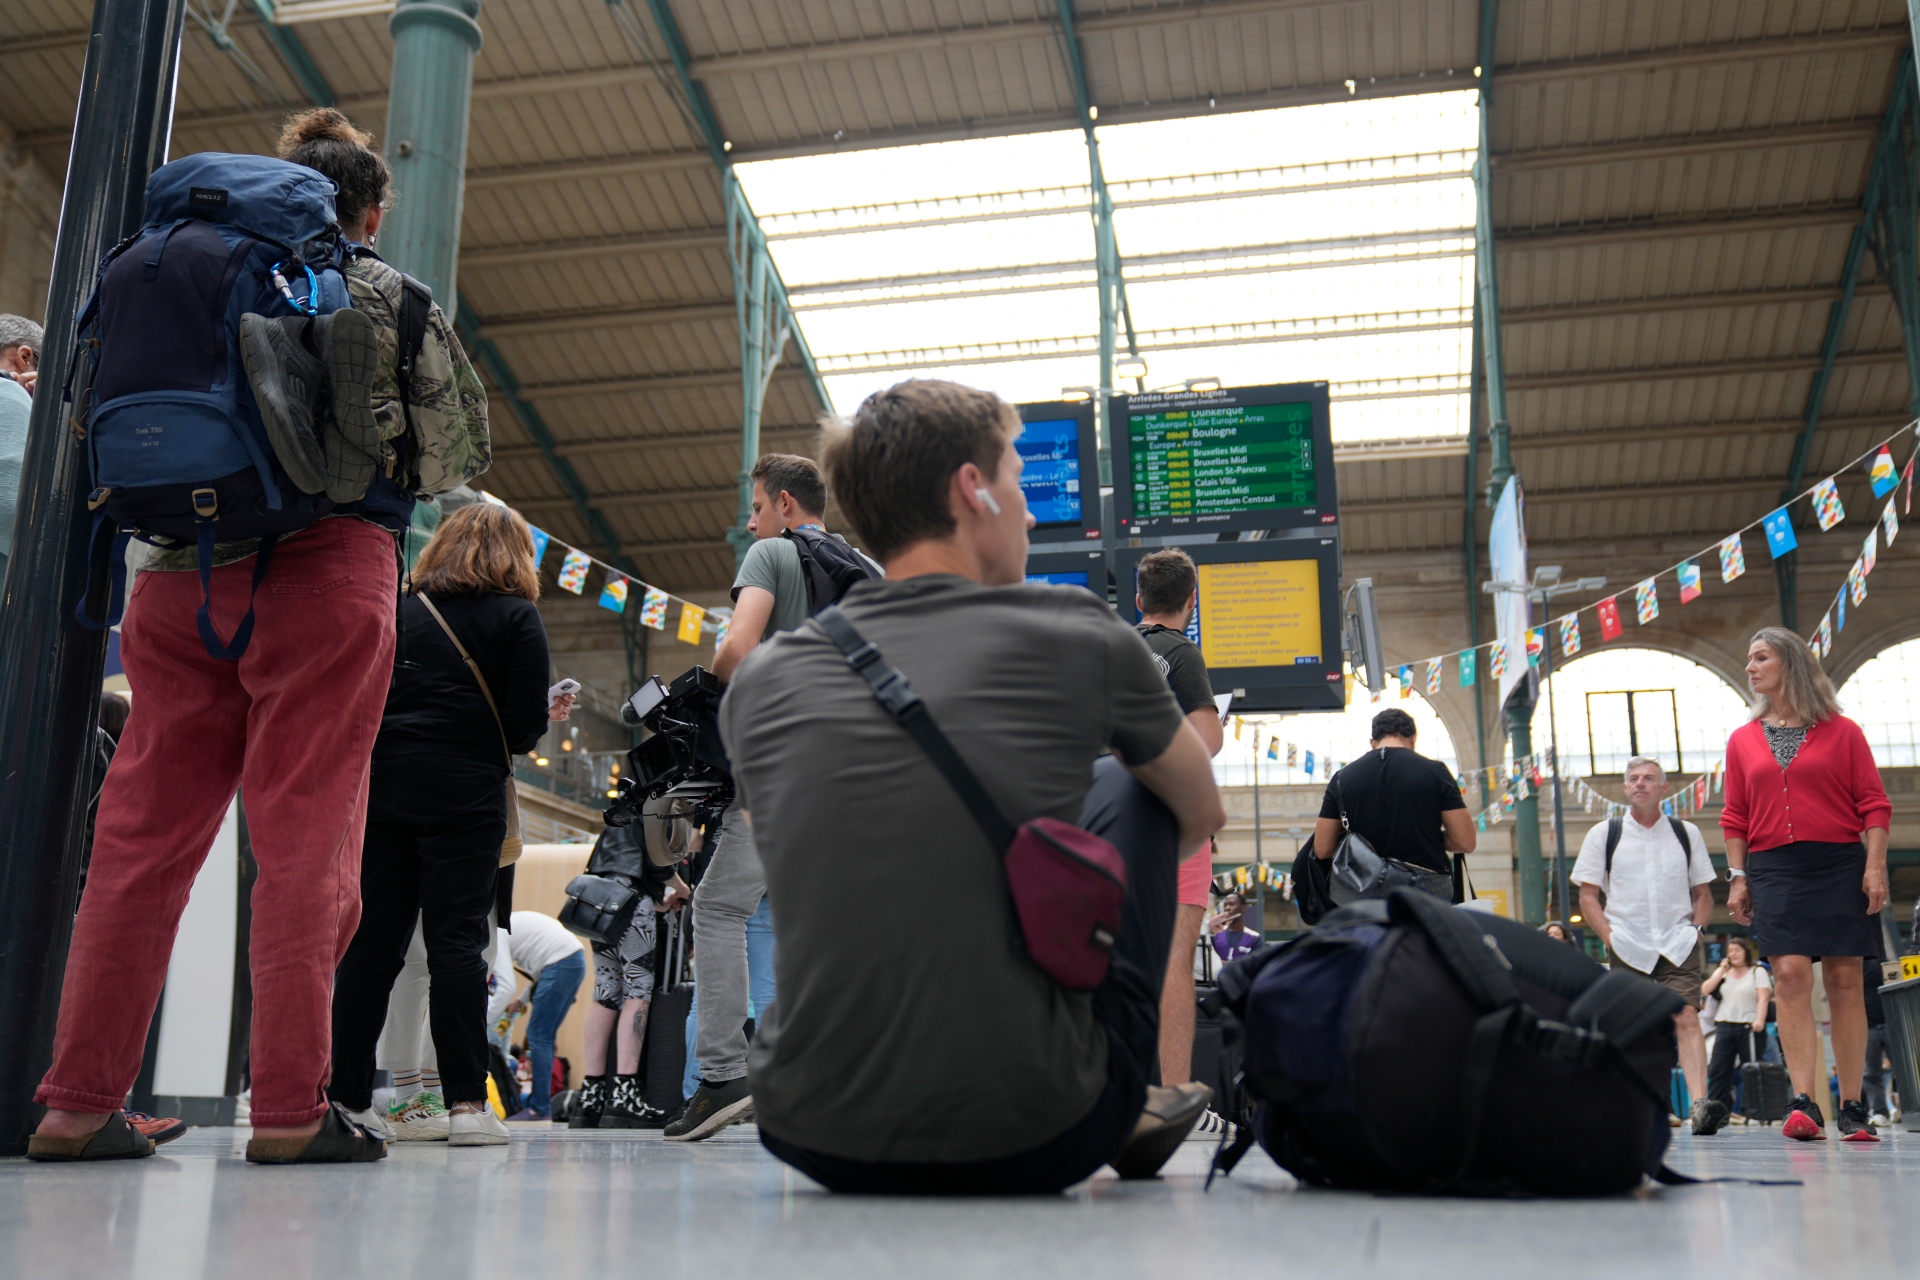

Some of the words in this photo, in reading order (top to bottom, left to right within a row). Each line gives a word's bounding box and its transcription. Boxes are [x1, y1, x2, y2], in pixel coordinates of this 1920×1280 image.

[1128, 394, 1162, 404] Arrivées
[1164, 391, 1198, 400] Grandes
[1200, 390, 1227, 399] Lignes
[1146, 420, 1187, 430] Dunkerque
[1193, 418, 1210, 427] Lille
[1212, 417, 1239, 426] Europe
[1192, 428, 1237, 438] Boulogne
[1149, 441, 1176, 450] Europe
[1194, 448, 1228, 456] Bruxelles
[1230, 446, 1247, 454] Midi
[1284, 410, 1306, 502] arrivées
[1021, 453, 1050, 461] ruxelles
[1194, 458, 1228, 467] Bruxelles
[1230, 456, 1248, 464] Midi
[1168, 470, 1190, 478] 09h20
[1194, 468, 1223, 477] London
[1226, 465, 1266, 474] St-Pancras
[1170, 480, 1190, 488] 09h30
[1195, 479, 1218, 487] Calais
[1219, 477, 1237, 485] Ville
[1196, 488, 1230, 497] Bruxelles
[1232, 486, 1249, 494] Midi
[1196, 498, 1240, 506] Amsterdam
[1242, 494, 1276, 504] Centraal
[1197, 514, 1230, 522] provenance
[1223, 571, 1261, 579] suppressions
[1256, 586, 1296, 594] allongements
[1244, 612, 1290, 620] recommandons
